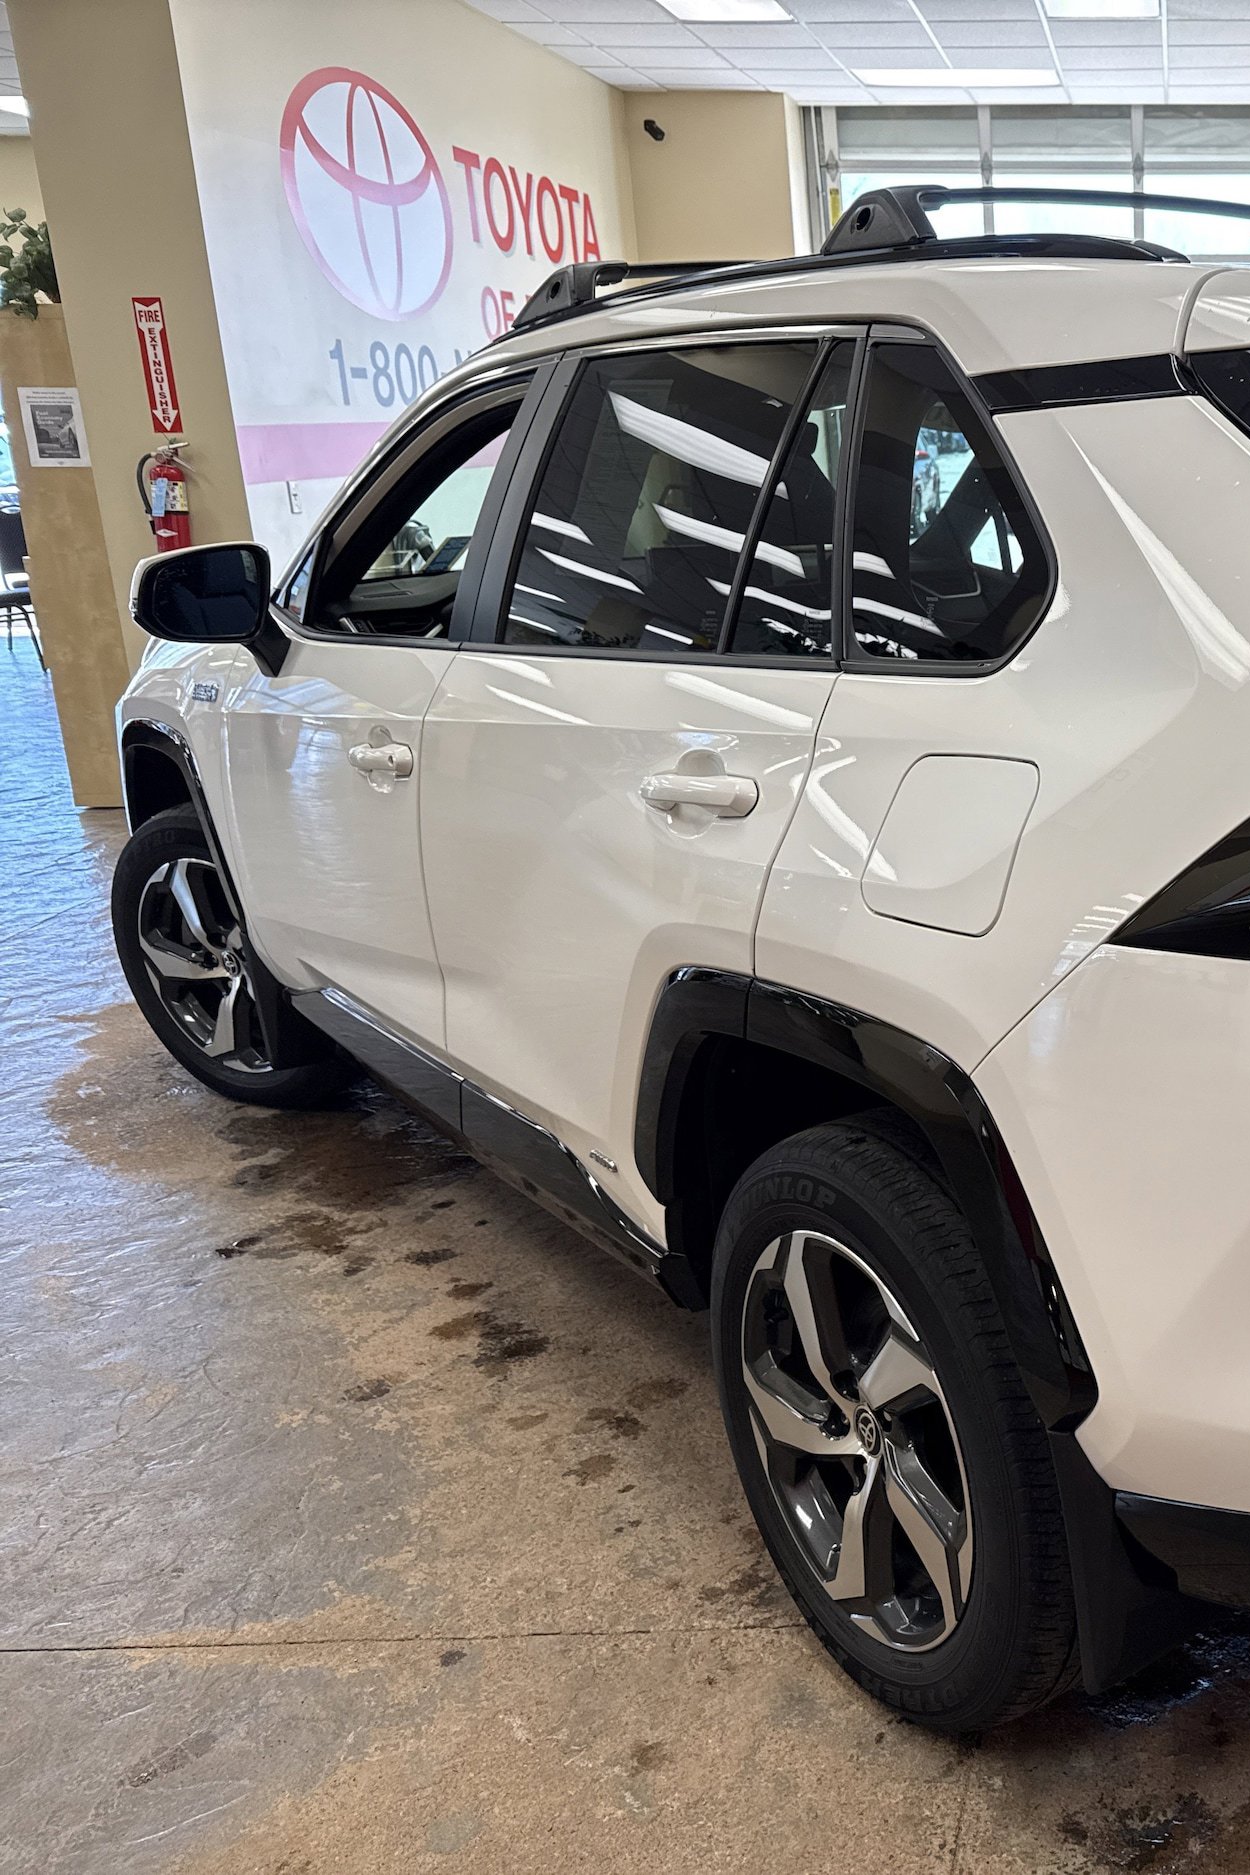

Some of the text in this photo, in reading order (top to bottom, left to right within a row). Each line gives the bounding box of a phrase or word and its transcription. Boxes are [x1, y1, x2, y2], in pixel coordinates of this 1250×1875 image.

[452, 145, 601, 264] TOYOTA
[138, 309, 161, 323] FIRE
[480, 286, 515, 342] OF
[147, 327, 172, 424] EXTINGUISHER
